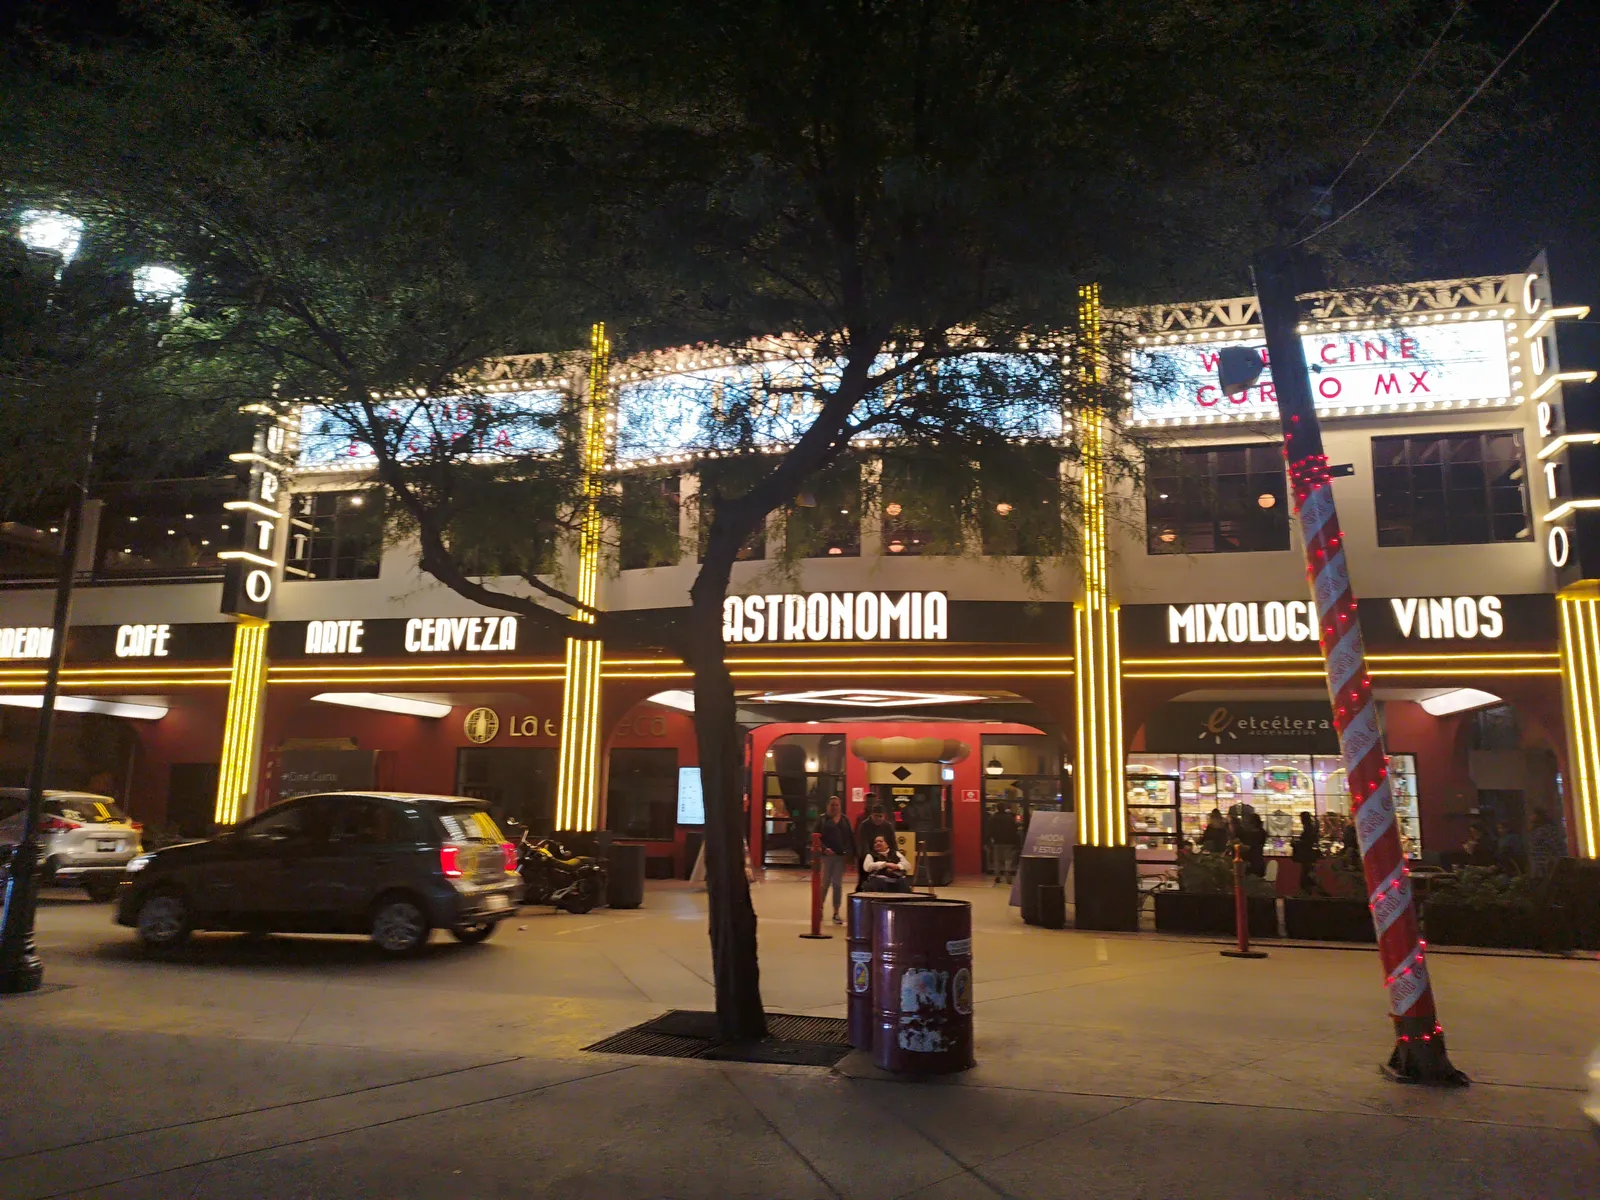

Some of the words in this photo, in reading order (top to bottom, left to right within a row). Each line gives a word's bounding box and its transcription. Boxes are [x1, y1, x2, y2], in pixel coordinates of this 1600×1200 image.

[1321, 337, 1415, 365] CINE
[1197, 371, 1342, 407] CURO
[1375, 370, 1431, 395] MX
[1523, 273, 1568, 567] CURTO
[246, 426, 285, 602] URTO
[404, 616, 518, 653] CERVEZA
[722, 590, 948, 642] ASTRONOMIA
[1168, 600, 1320, 643] MIXOLOGI
[1390, 595, 1504, 639] VINOS
[115, 624, 171, 658] CAFE
[305, 620, 364, 654] ARTE
[1237, 716, 1330, 730] etcétera
